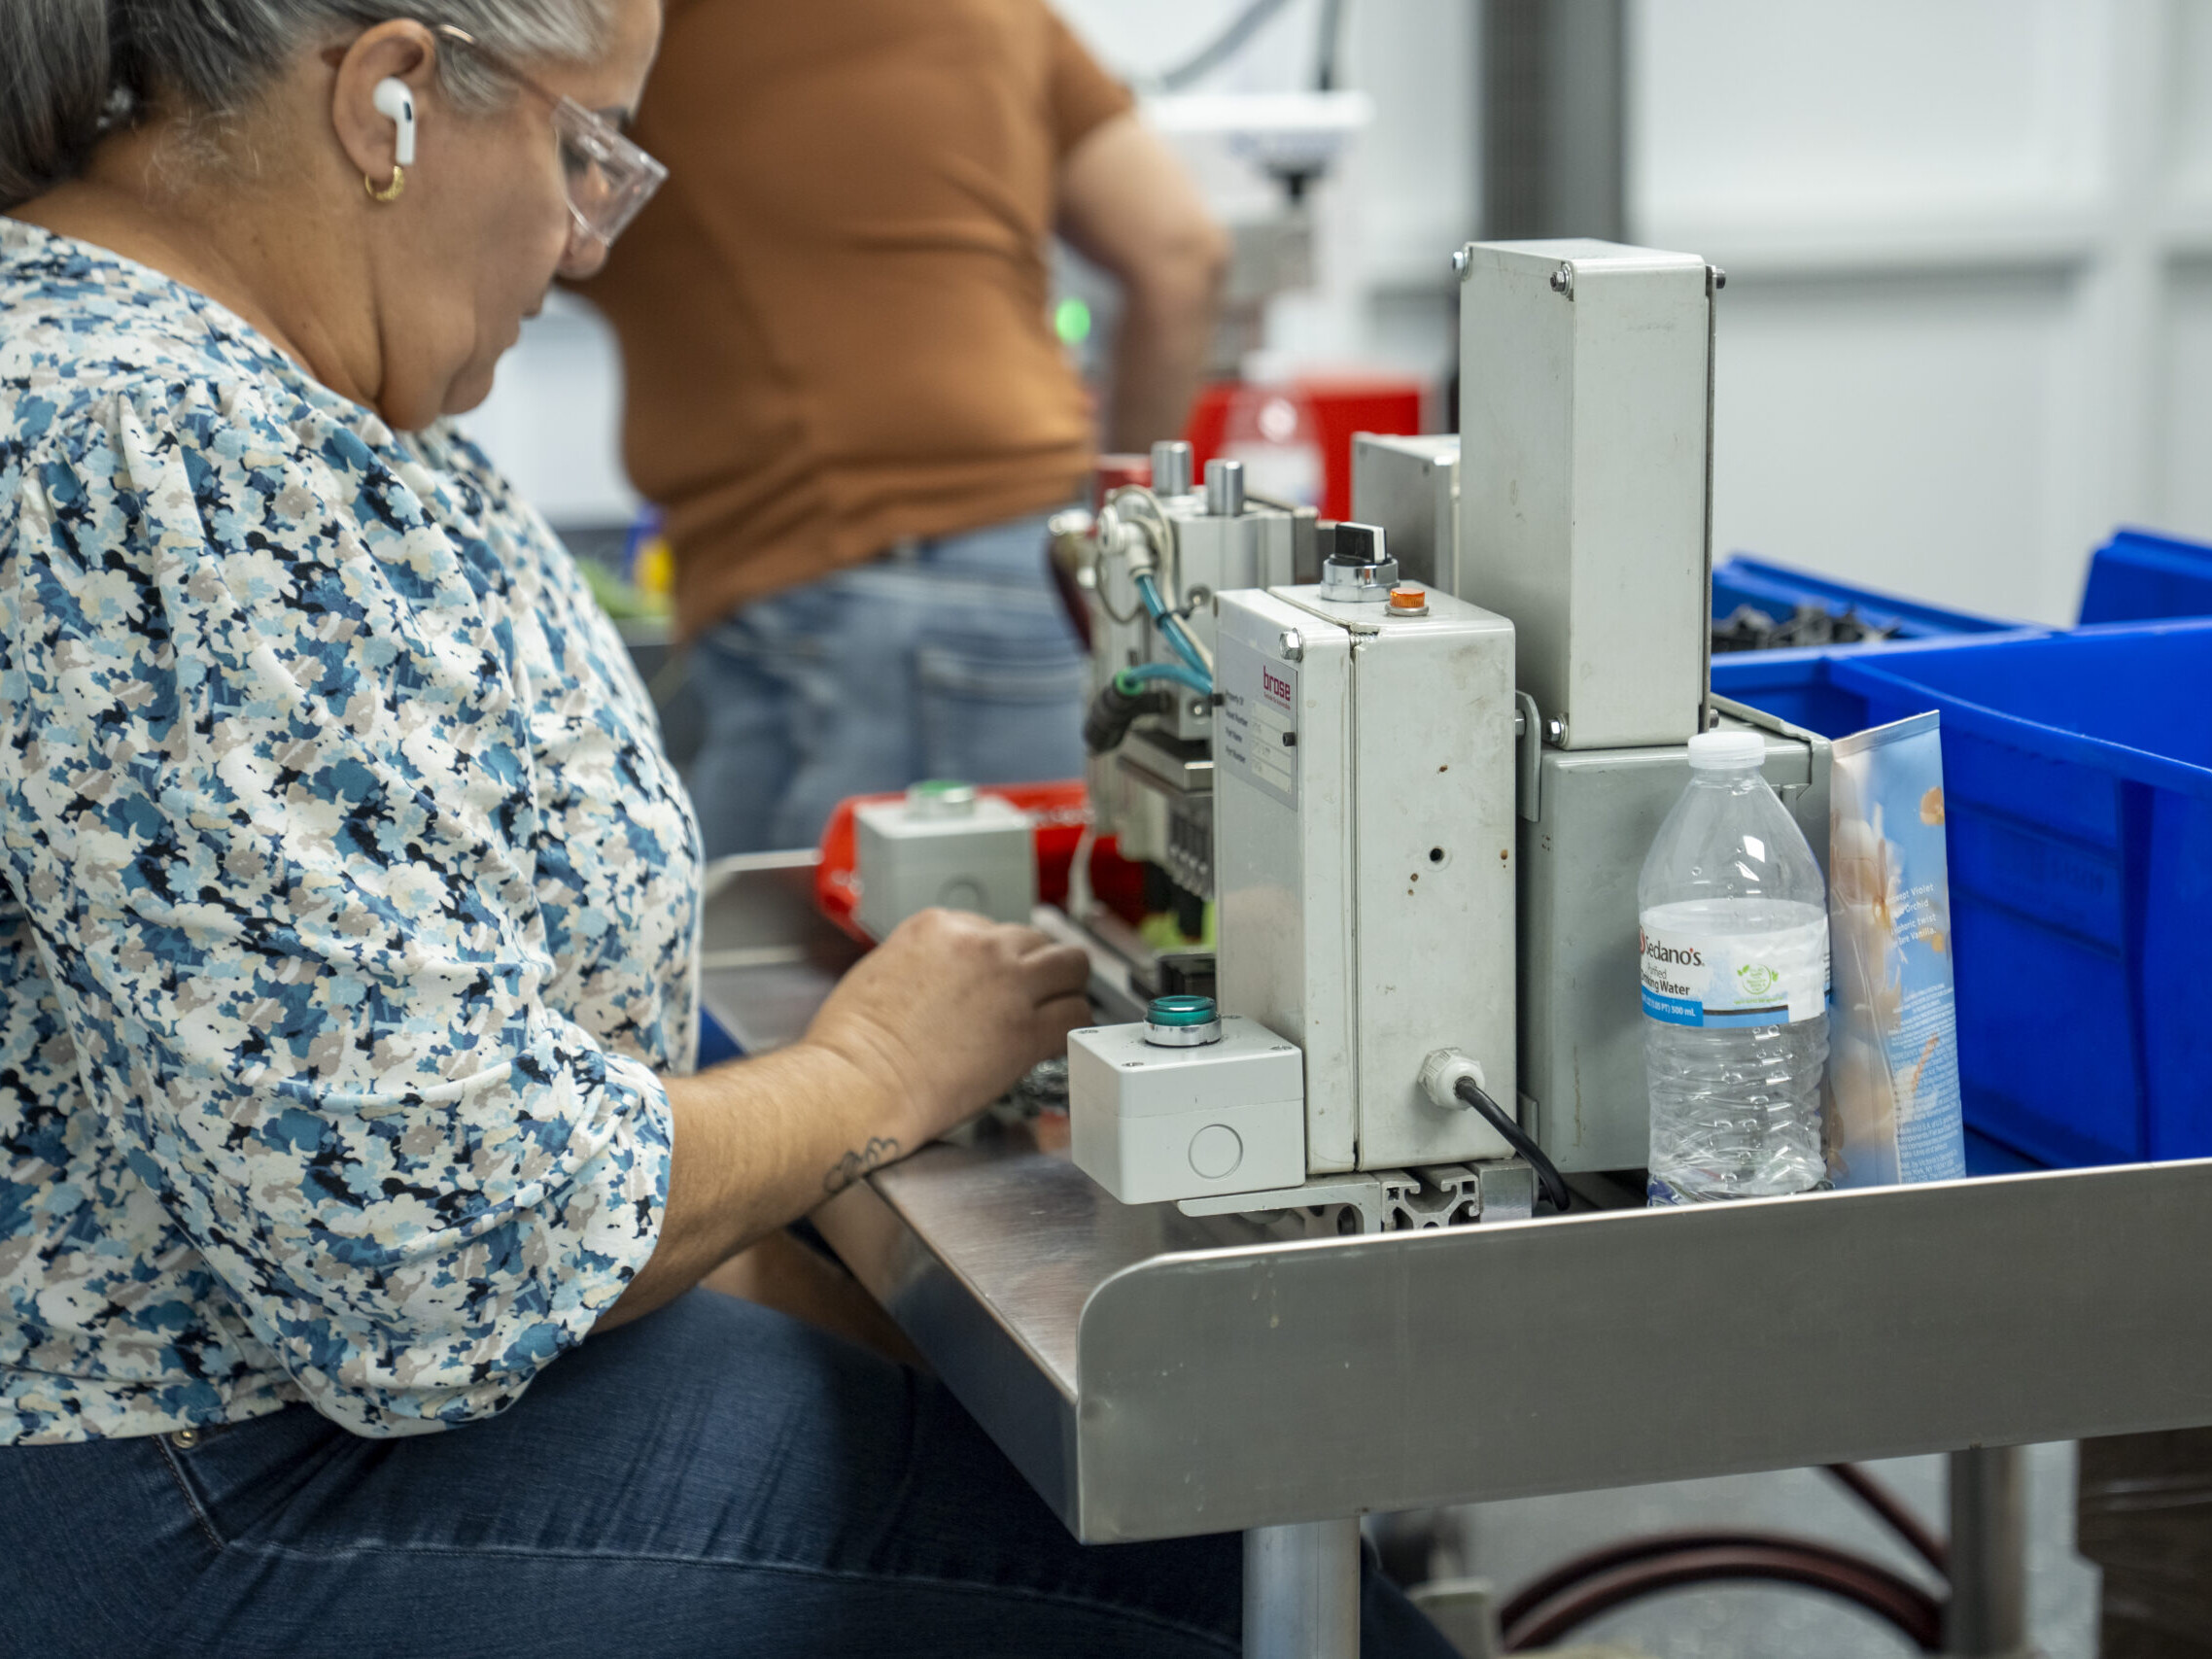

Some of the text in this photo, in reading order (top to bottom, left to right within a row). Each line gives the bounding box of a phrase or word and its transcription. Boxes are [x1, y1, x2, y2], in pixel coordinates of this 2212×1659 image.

[1263, 665, 1291, 701] brose
[1911, 883, 1933, 896] Violet
[1905, 898, 1929, 913] Orchid
[1918, 914, 1937, 926] twist
[1911, 927, 1937, 940] Vanilla.
[1645, 935, 1702, 966] Sedano's
[1660, 980, 1690, 995] Water
[1671, 1005, 1683, 1015] 500
[1684, 1007, 1696, 1017] mL
